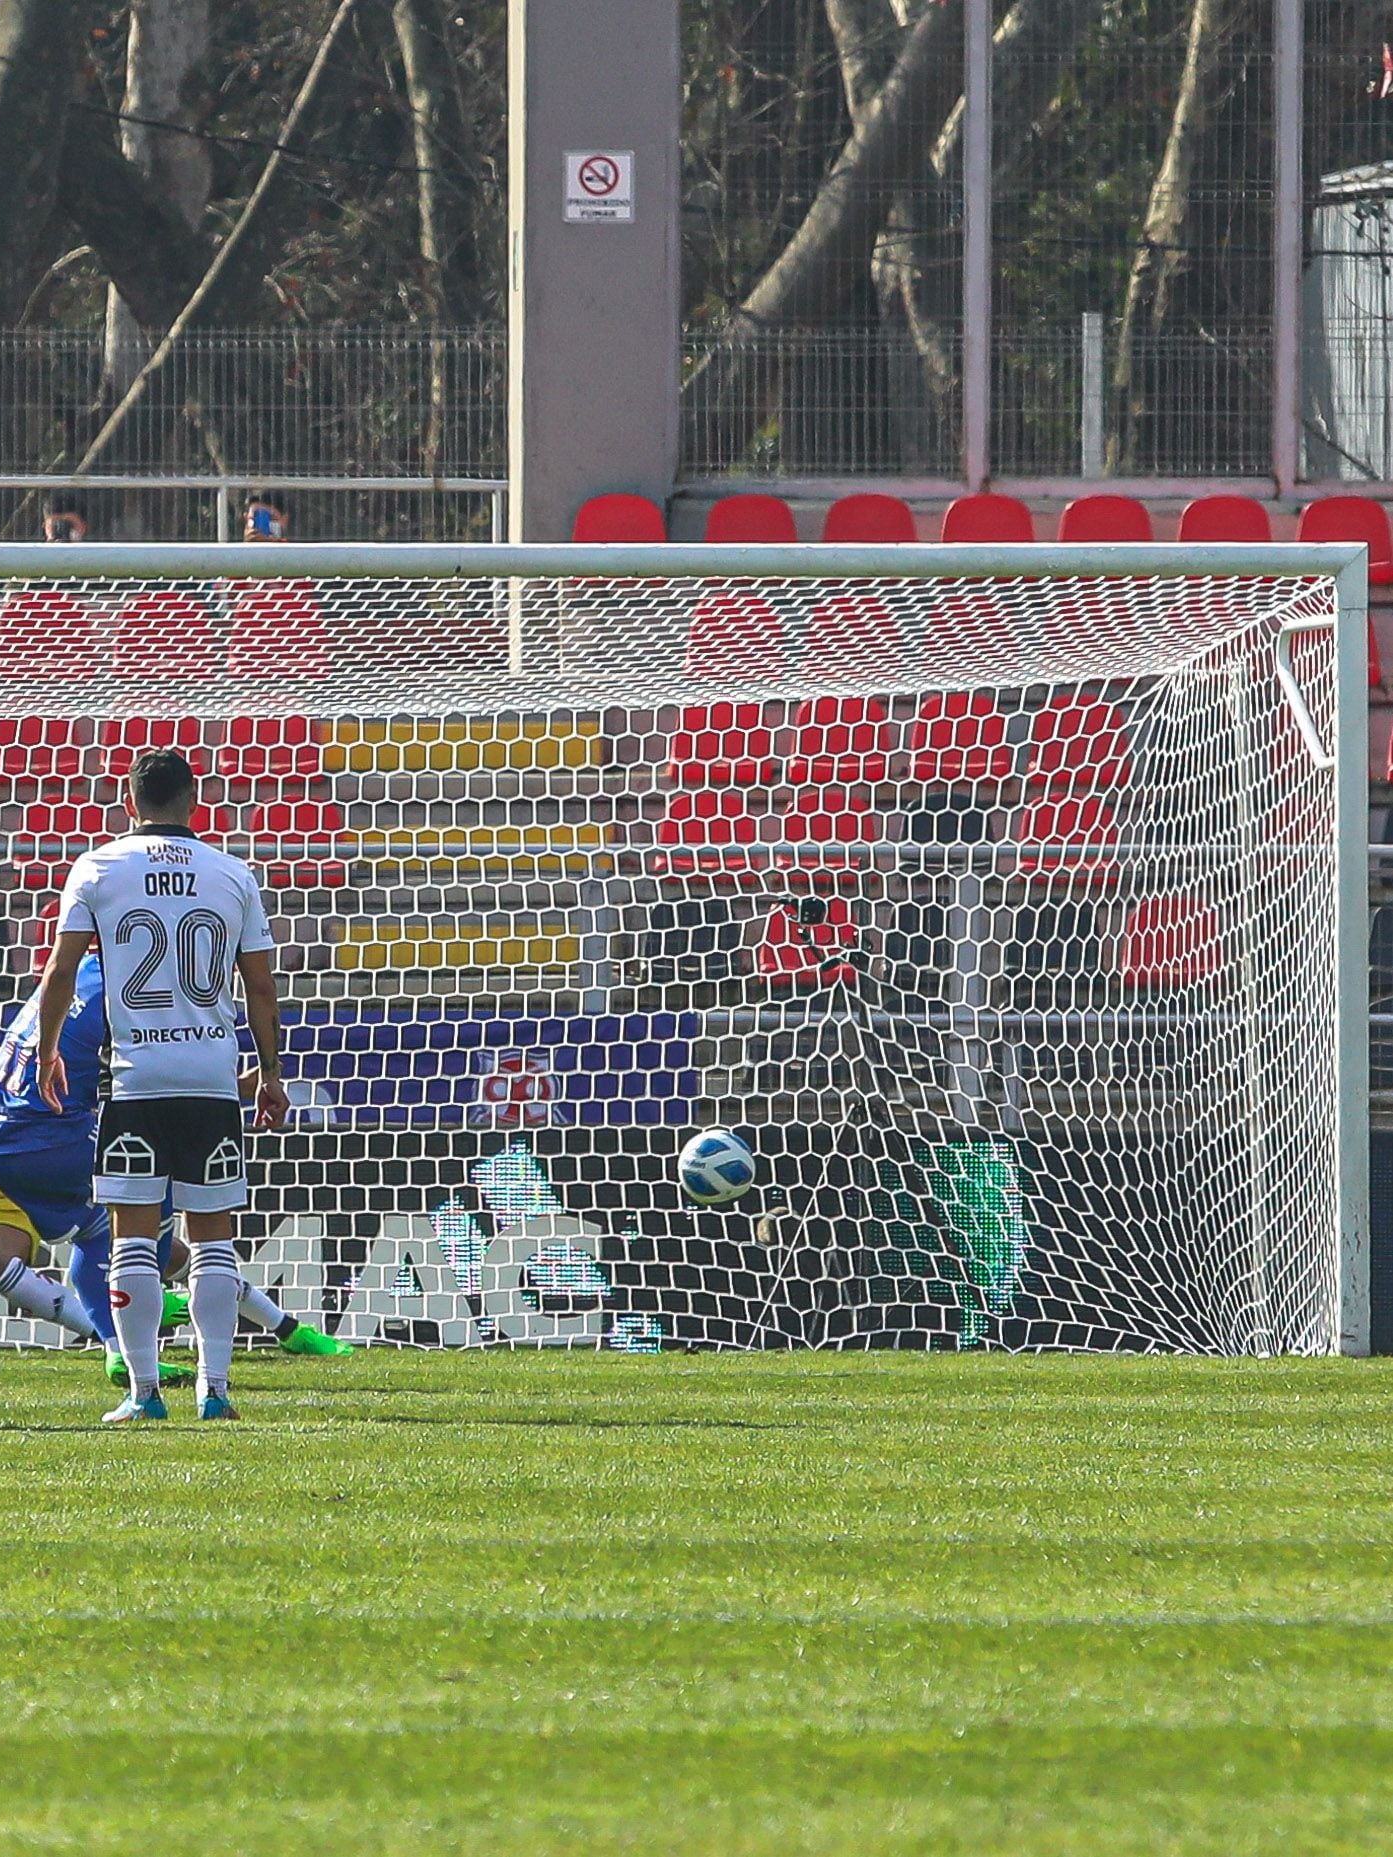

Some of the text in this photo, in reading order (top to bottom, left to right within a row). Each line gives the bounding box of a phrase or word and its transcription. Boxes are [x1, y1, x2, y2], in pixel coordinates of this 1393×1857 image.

[144, 872, 198, 897] OROZ
[115, 907, 228, 1009] 20
[130, 1026, 226, 1044] DIRECTV GO
